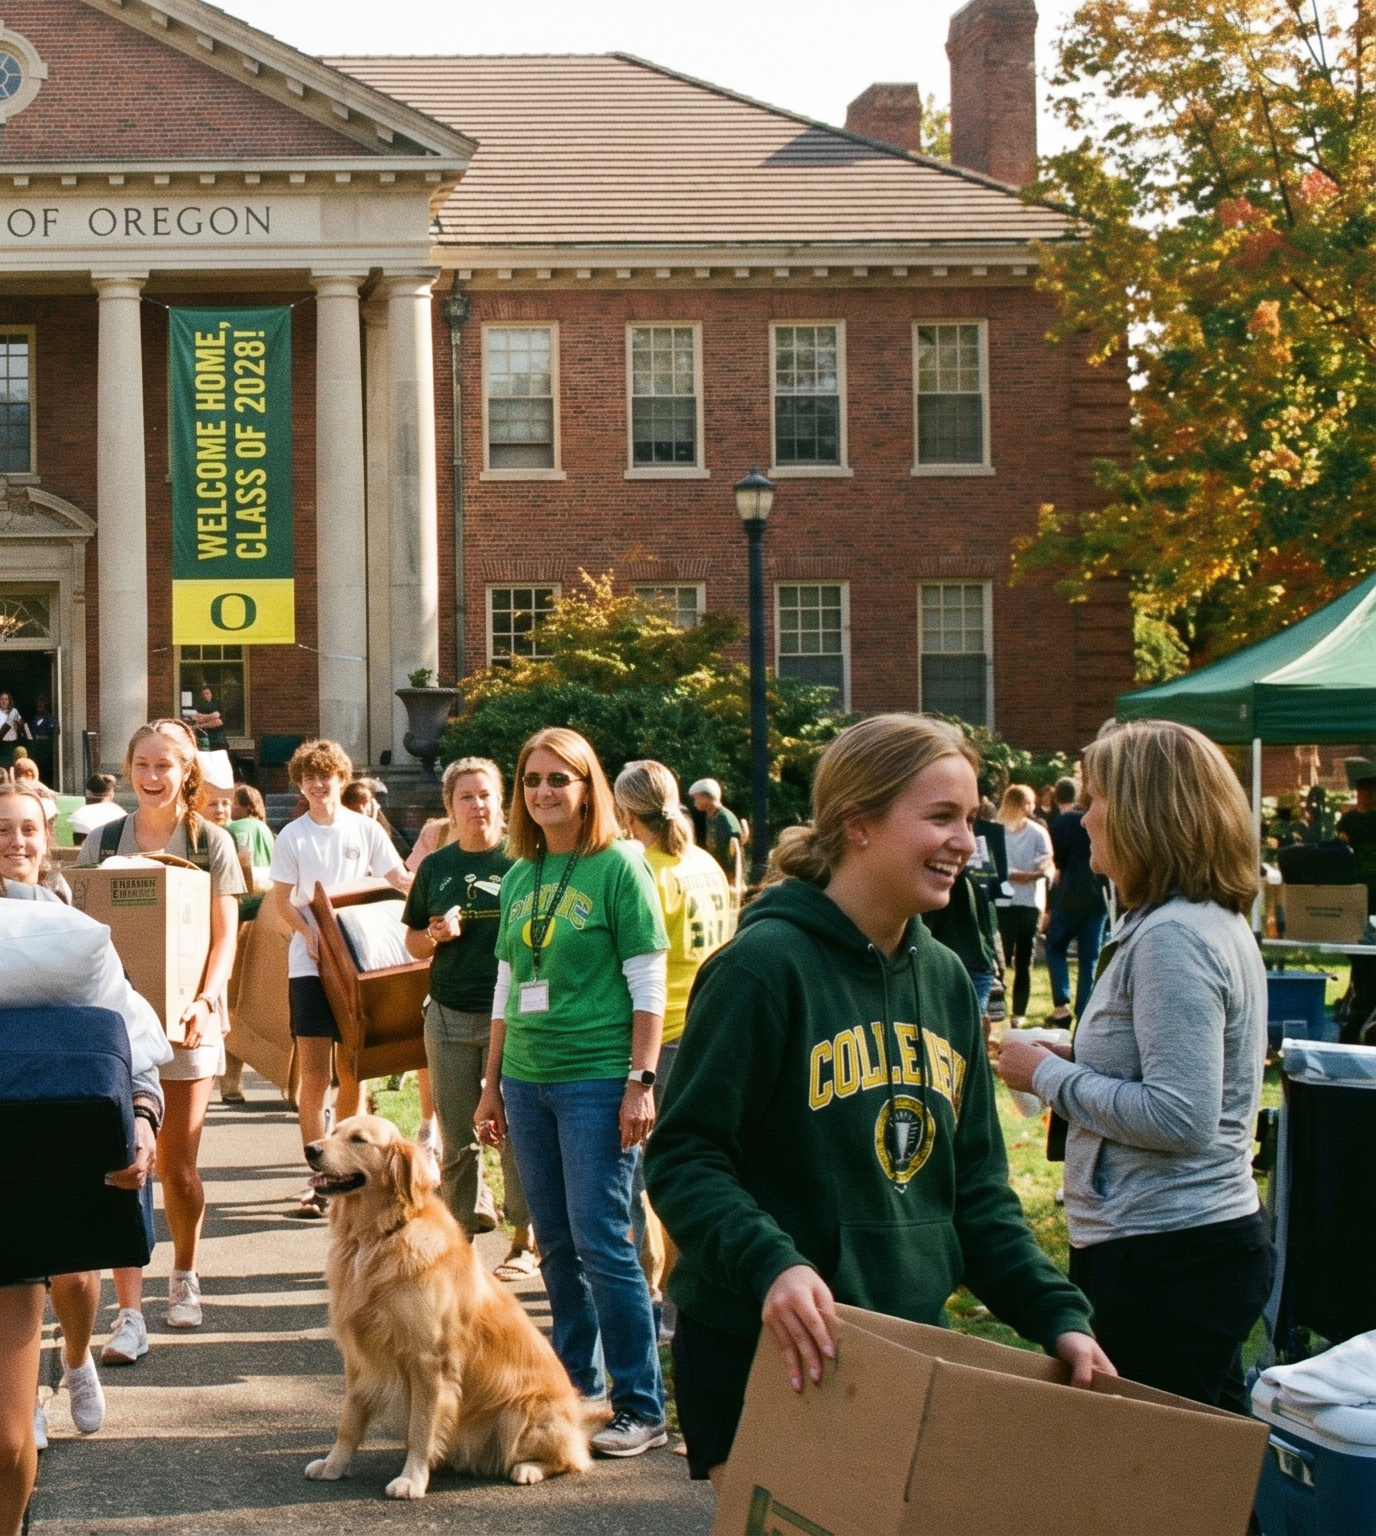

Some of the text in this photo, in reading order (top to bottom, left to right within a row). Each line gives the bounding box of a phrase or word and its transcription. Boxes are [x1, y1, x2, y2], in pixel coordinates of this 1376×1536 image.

[6, 207, 59, 238] OF
[88, 205, 271, 237] OREGON
[195, 322, 231, 560] WELCOME HOME,
[233, 330, 268, 559] CLASS OF 2028!
[209, 592, 257, 631] O
